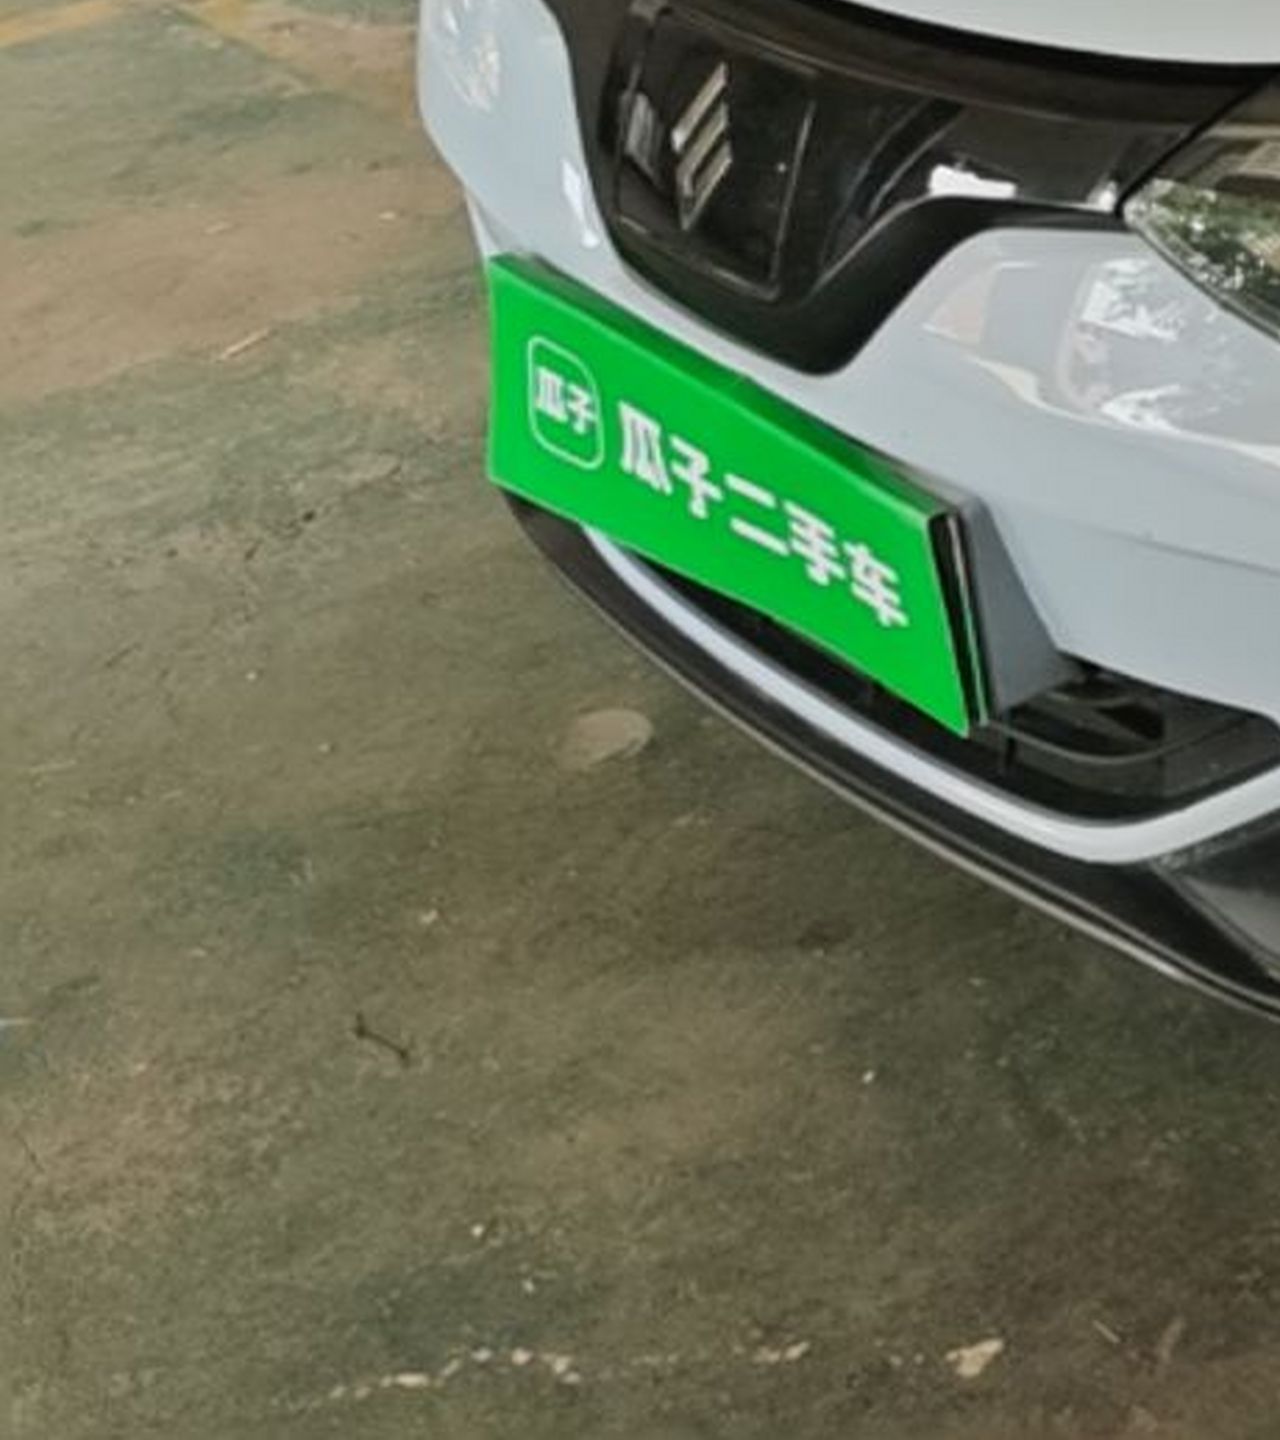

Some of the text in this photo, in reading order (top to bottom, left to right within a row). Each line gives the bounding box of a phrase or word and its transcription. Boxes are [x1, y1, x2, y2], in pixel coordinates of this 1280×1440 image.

[535, 366, 599, 434] 瓜子
[617, 399, 909, 627] 瓜子二手车
